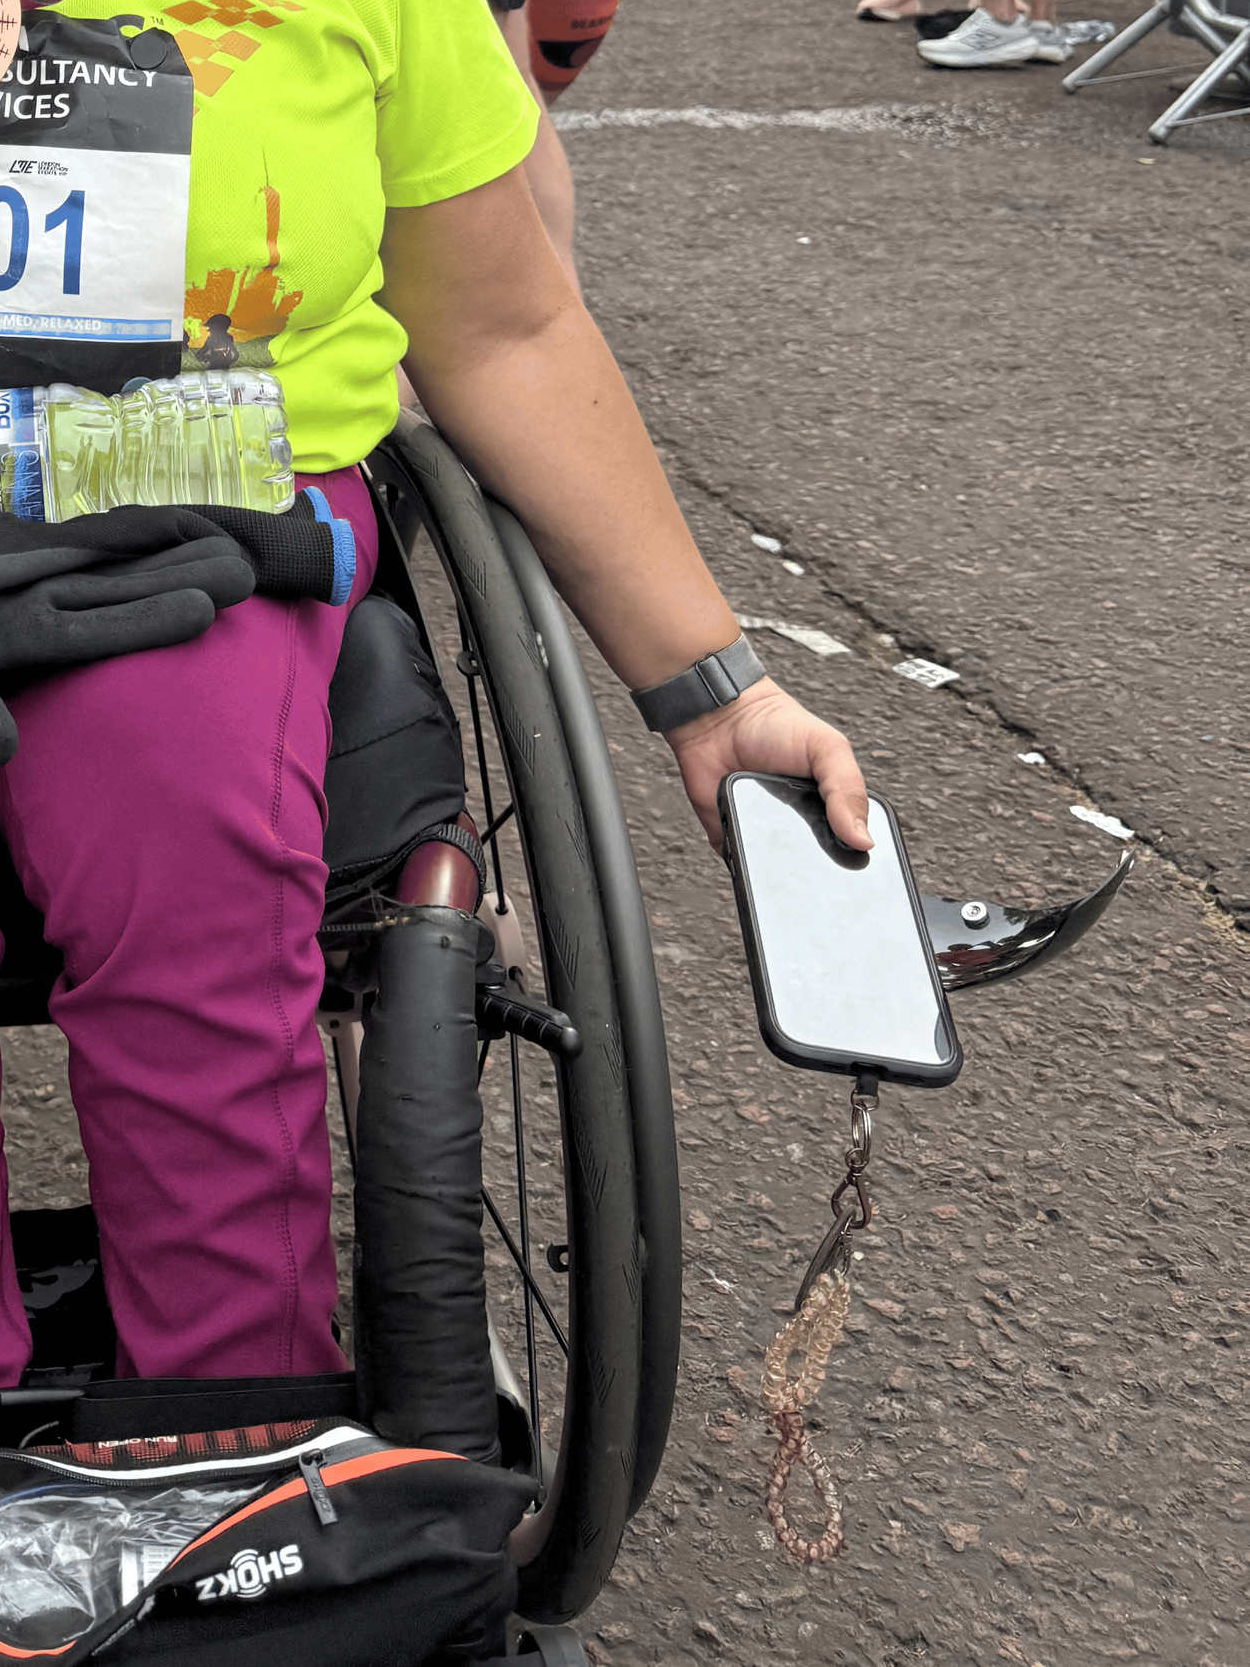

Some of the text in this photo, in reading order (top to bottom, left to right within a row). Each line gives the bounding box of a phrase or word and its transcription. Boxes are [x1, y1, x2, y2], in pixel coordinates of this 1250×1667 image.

[151, 16, 164, 26] TM
[40, 317, 102, 332] RELAXED
[195, 1544, 304, 1600] SHOKZ
